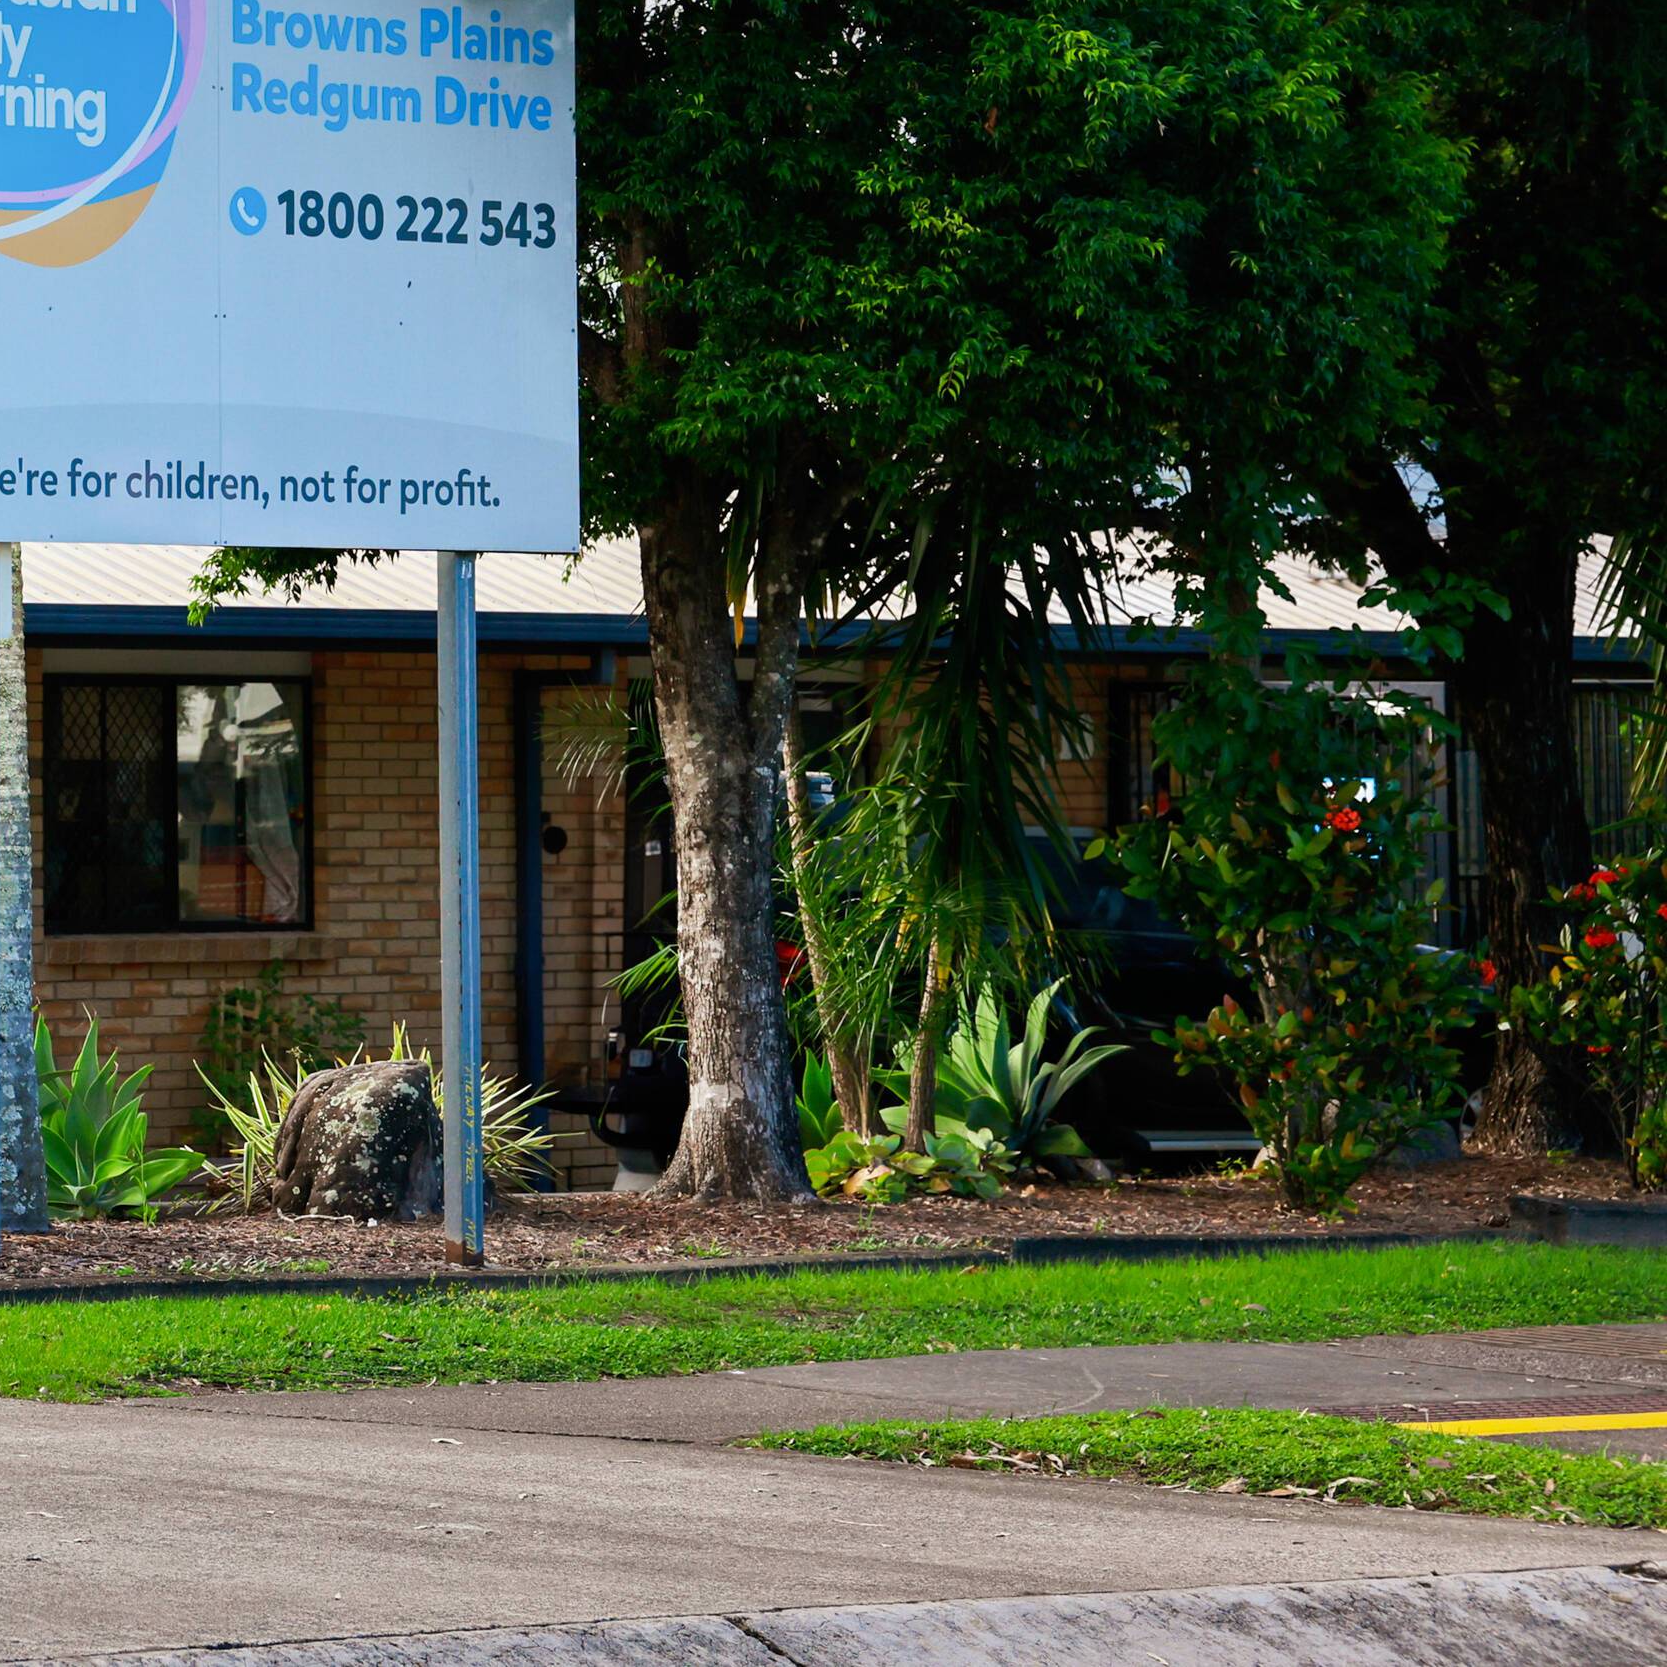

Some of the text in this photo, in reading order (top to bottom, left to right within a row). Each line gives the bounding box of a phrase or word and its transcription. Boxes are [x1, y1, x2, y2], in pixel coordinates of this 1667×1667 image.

[420, 5, 554, 67] Plains
[231, 63, 552, 134] Redgum Drive
[277, 188, 557, 251] 1800 222 543
[67, 459, 117, 499] for
[125, 460, 271, 510] children,
[279, 472, 335, 506] not
[343, 466, 392, 507] for
[400, 467, 501, 515] profit.
